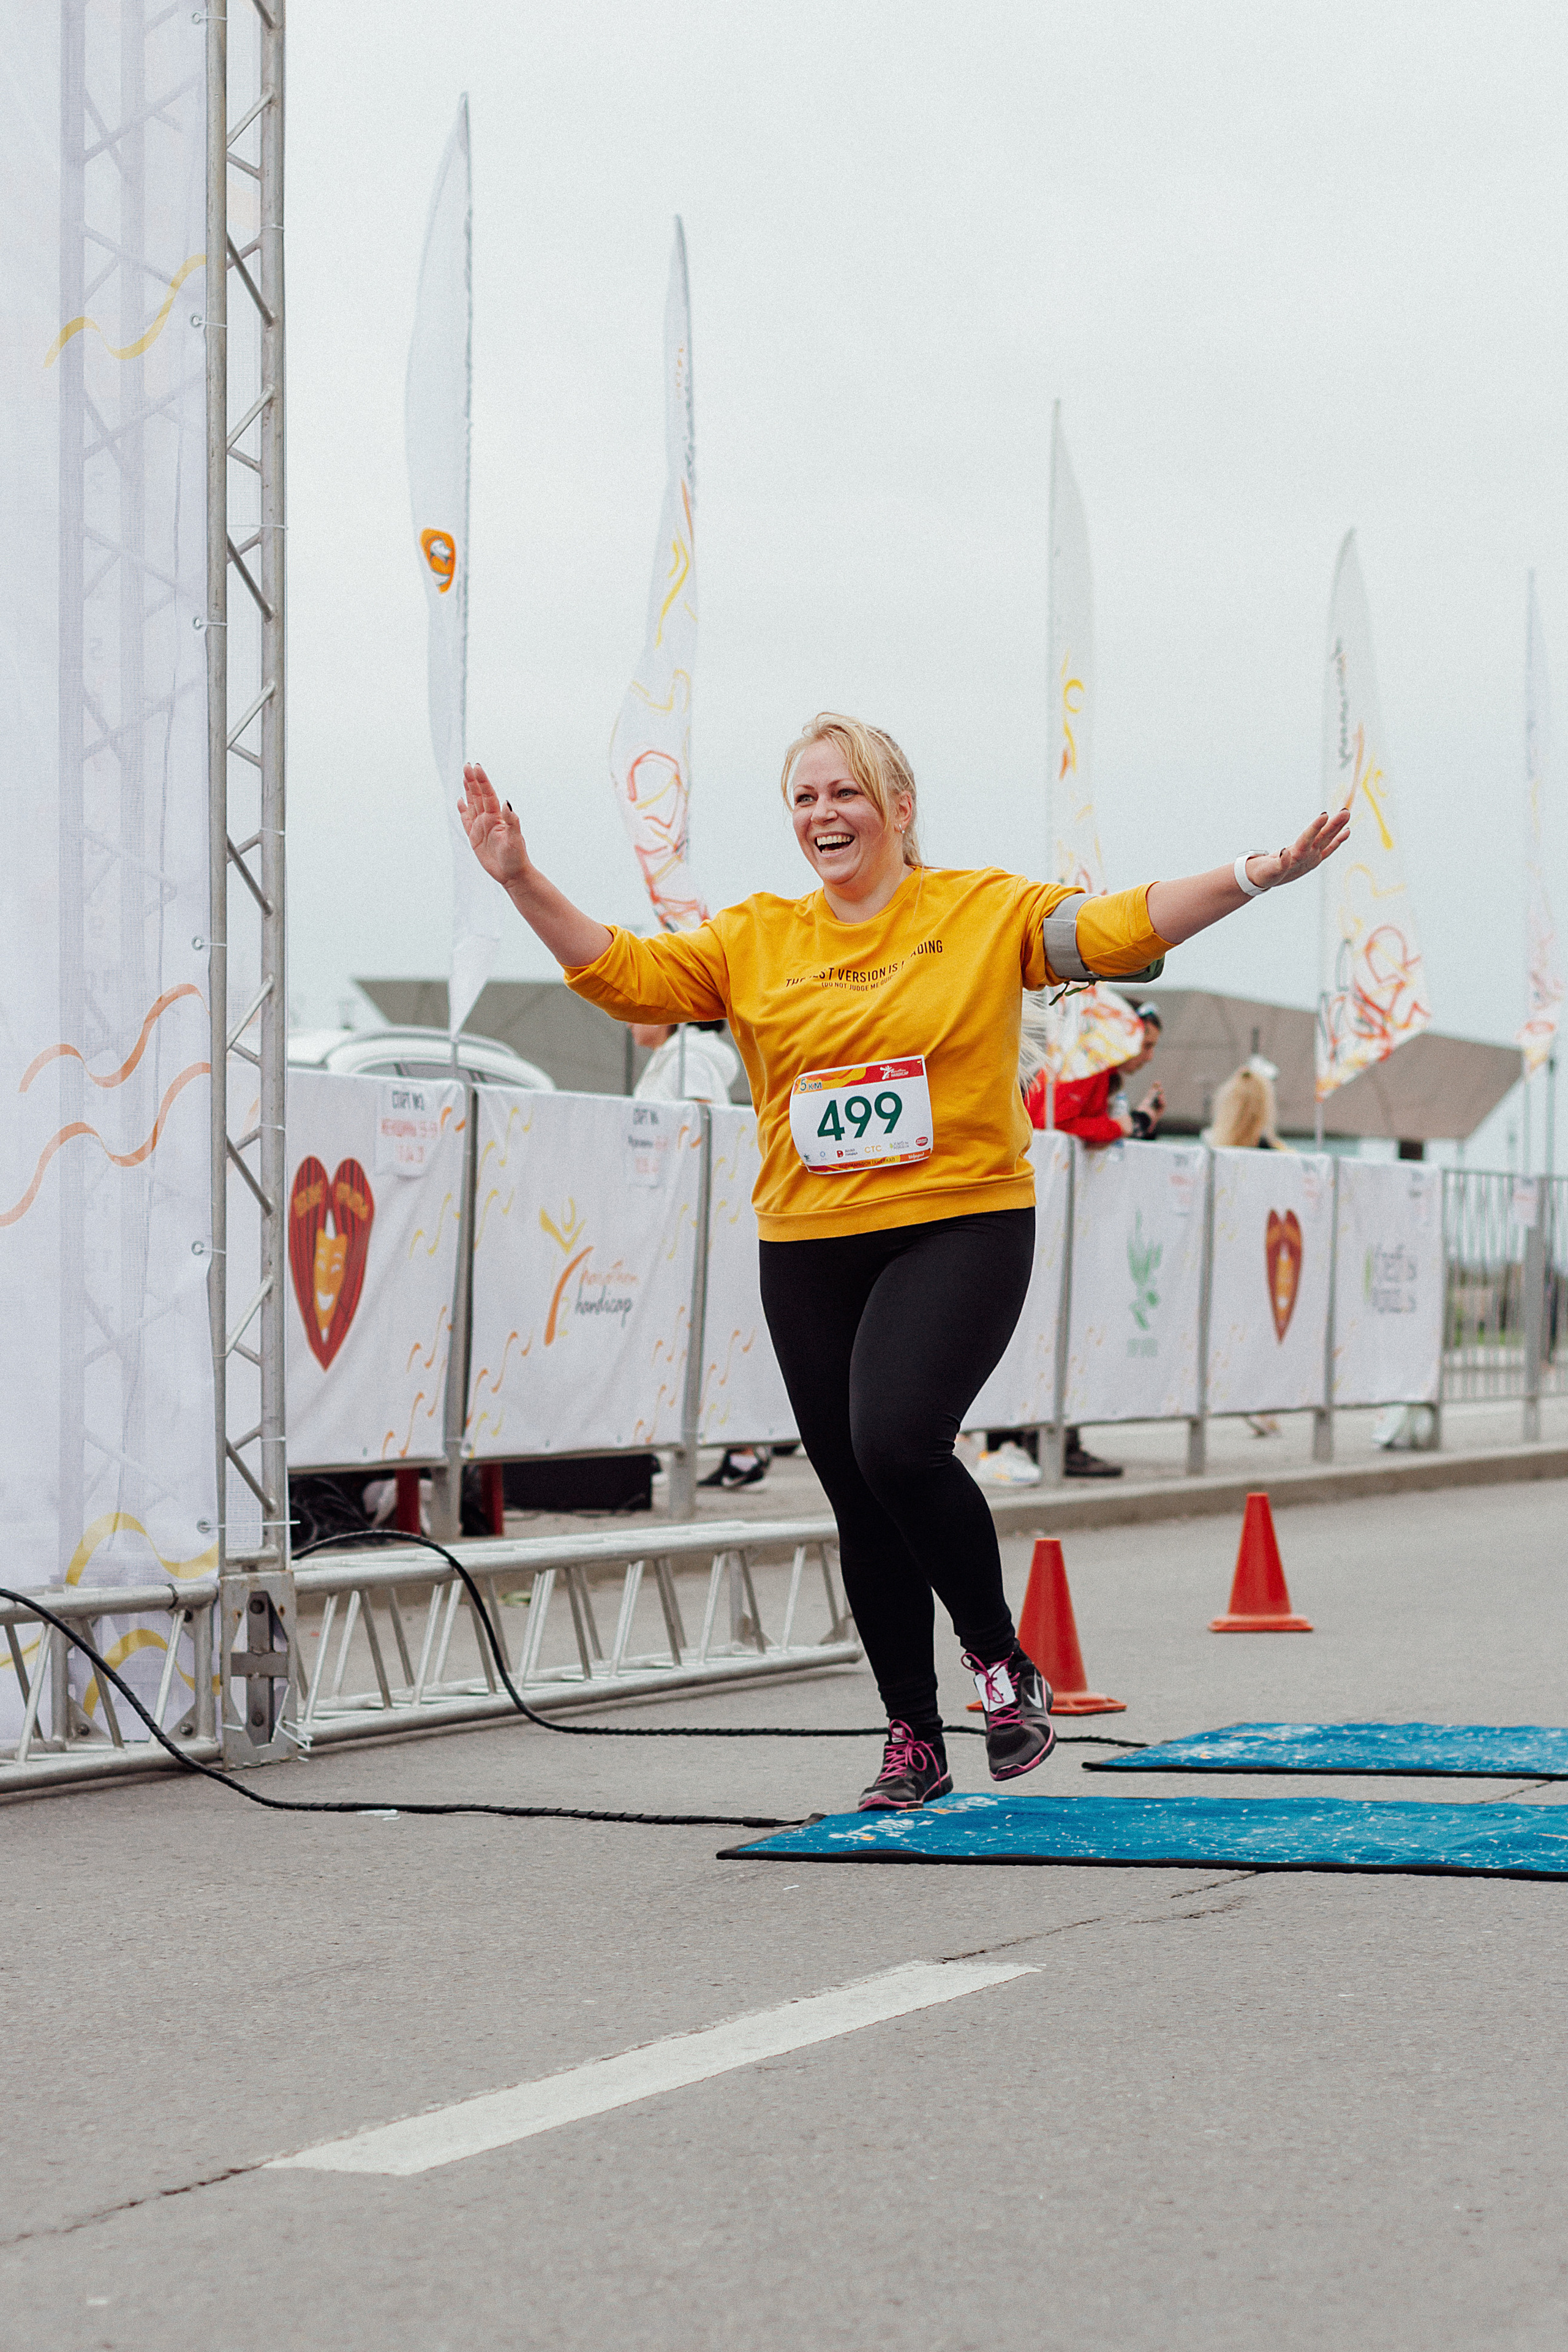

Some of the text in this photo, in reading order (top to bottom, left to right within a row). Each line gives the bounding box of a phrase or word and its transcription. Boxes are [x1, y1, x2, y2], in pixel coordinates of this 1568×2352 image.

[837, 967, 886, 983] VERSION
[889, 962, 898, 974] IS
[800, 1078, 807, 1091] 5
[817, 1091, 903, 1141] 499
[575, 1285, 633, 1329] handicap
